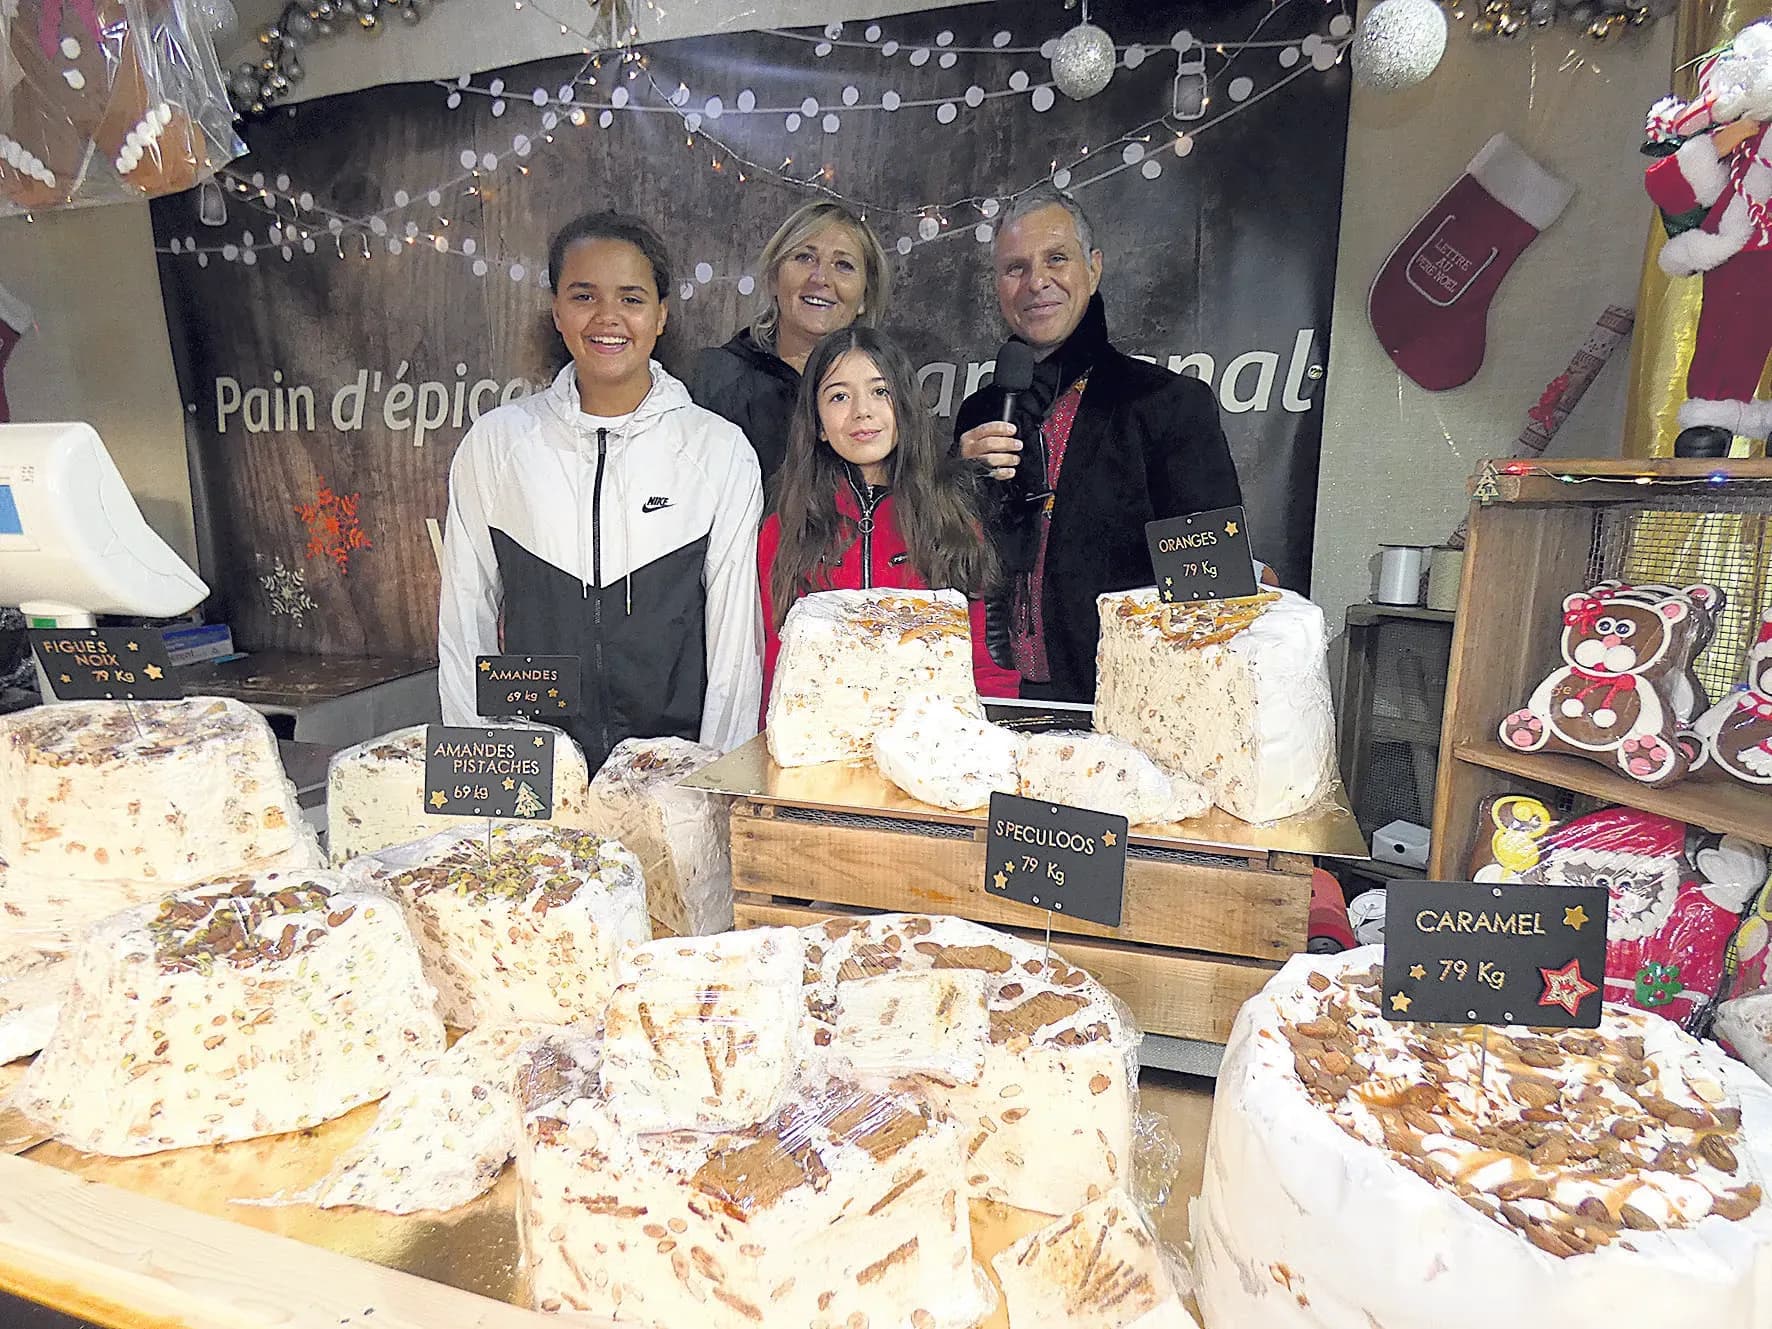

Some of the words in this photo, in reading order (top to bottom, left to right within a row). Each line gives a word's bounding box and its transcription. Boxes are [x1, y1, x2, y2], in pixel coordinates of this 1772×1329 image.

[1434, 238, 1472, 271] LETTRE
[1436, 257, 1453, 272] AU
[216, 369, 316, 433] Pain
[331, 360, 536, 447] d'épice
[647, 496, 669, 506] NIKE
[1159, 531, 1217, 553] ORANGES
[1183, 563, 1197, 577] 79
[1202, 560, 1218, 578] Kg
[43, 641, 108, 654] FIGUES
[74, 654, 119, 667] NOIX
[92, 670, 109, 681] 79
[115, 670, 135, 683] Kg
[489, 670, 558, 681] AMANDES
[507, 691, 520, 702] 69
[434, 743, 515, 758] AMANDES
[453, 760, 540, 775] PISTACHES
[454, 786, 471, 799] 69
[995, 820, 1095, 855] SPECULOOS
[1021, 855, 1039, 873] 79
[1047, 861, 1065, 886] Kg
[1415, 910, 1546, 936] CARAMEL
[1438, 959, 1469, 982] 79
[1477, 960, 1506, 990] Kg
